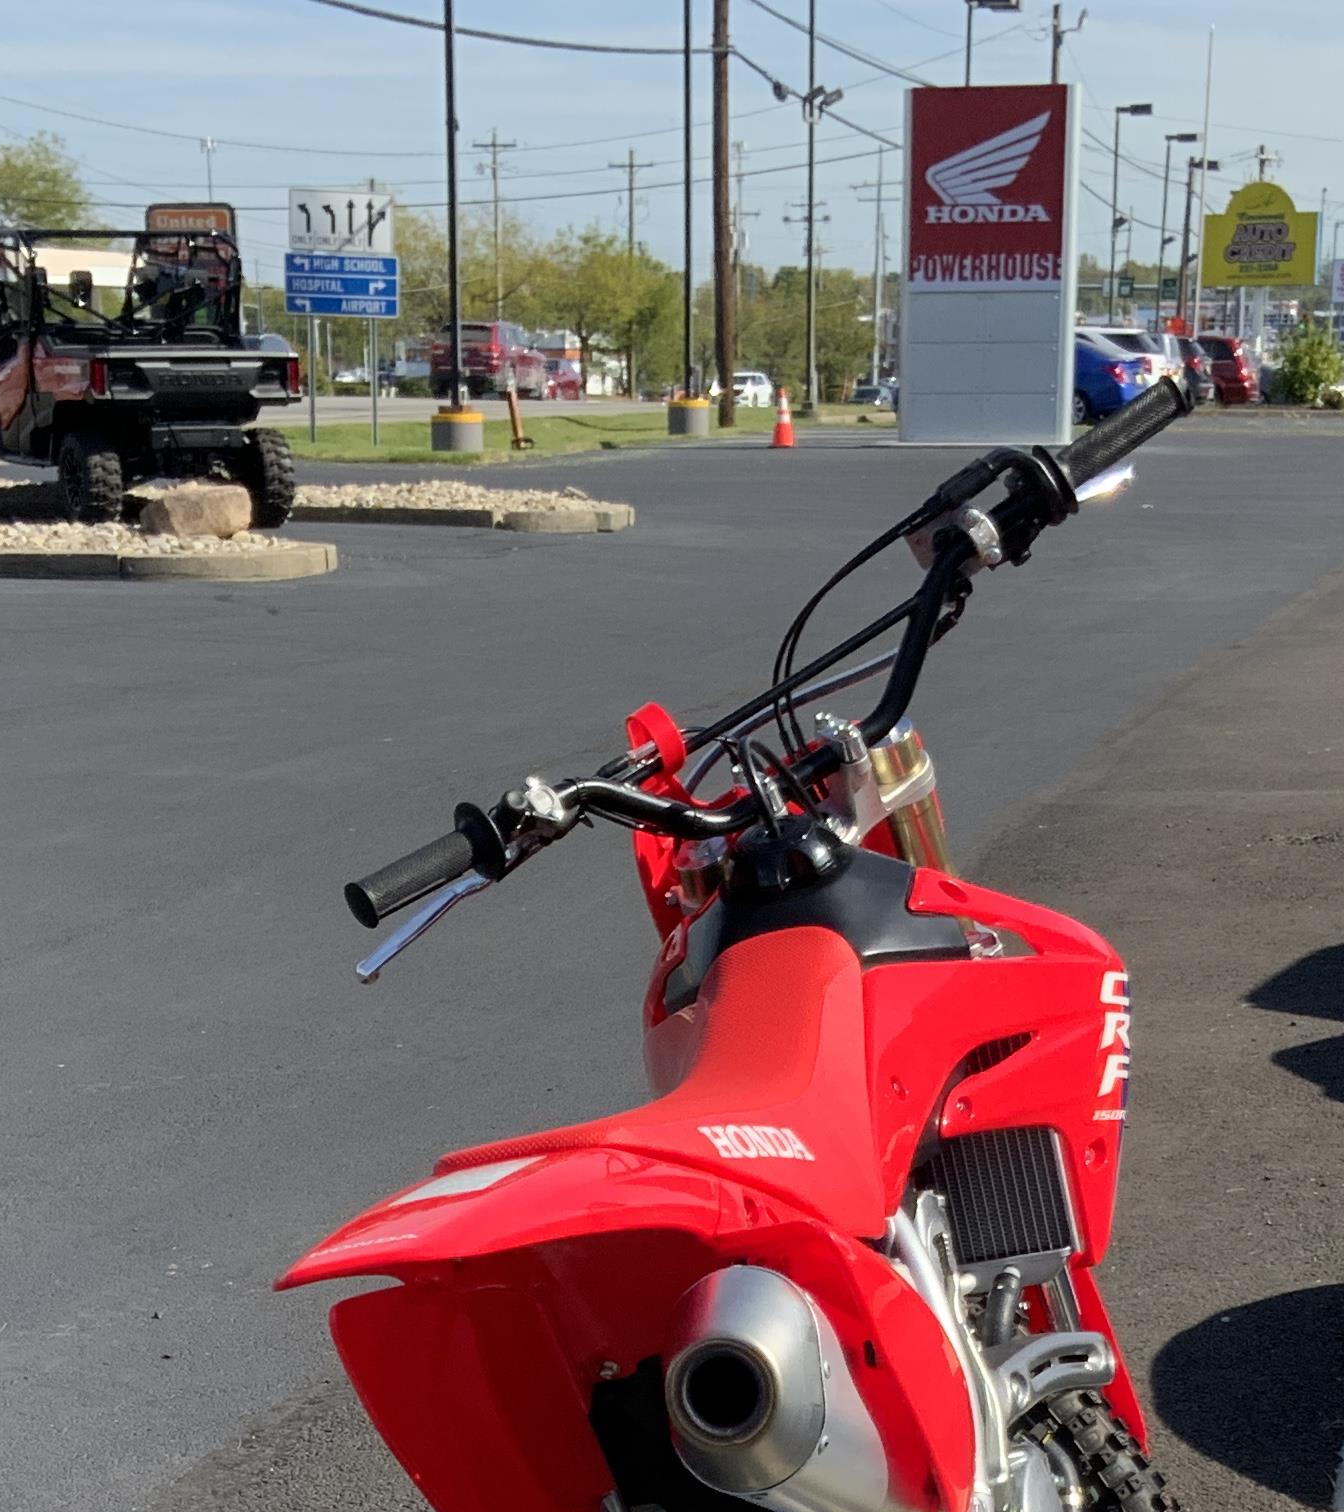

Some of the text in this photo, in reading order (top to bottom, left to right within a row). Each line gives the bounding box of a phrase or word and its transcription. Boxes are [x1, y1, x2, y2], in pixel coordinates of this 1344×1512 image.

[157, 216, 216, 229] United
[925, 204, 1051, 224] HONDA
[1232, 223, 1289, 241] AUTO
[1223, 242, 1296, 263] CREDIT
[313, 257, 386, 272] HIGH SCHOOL
[908, 252, 1062, 282] POWERHOUSE
[291, 278, 344, 292] HOSPITAL
[340, 299, 386, 313] AIRPORT
[1097, 971, 1131, 1098] CRF
[1092, 1109, 1127, 1121] 150R
[696, 1124, 815, 1161] HONDA
